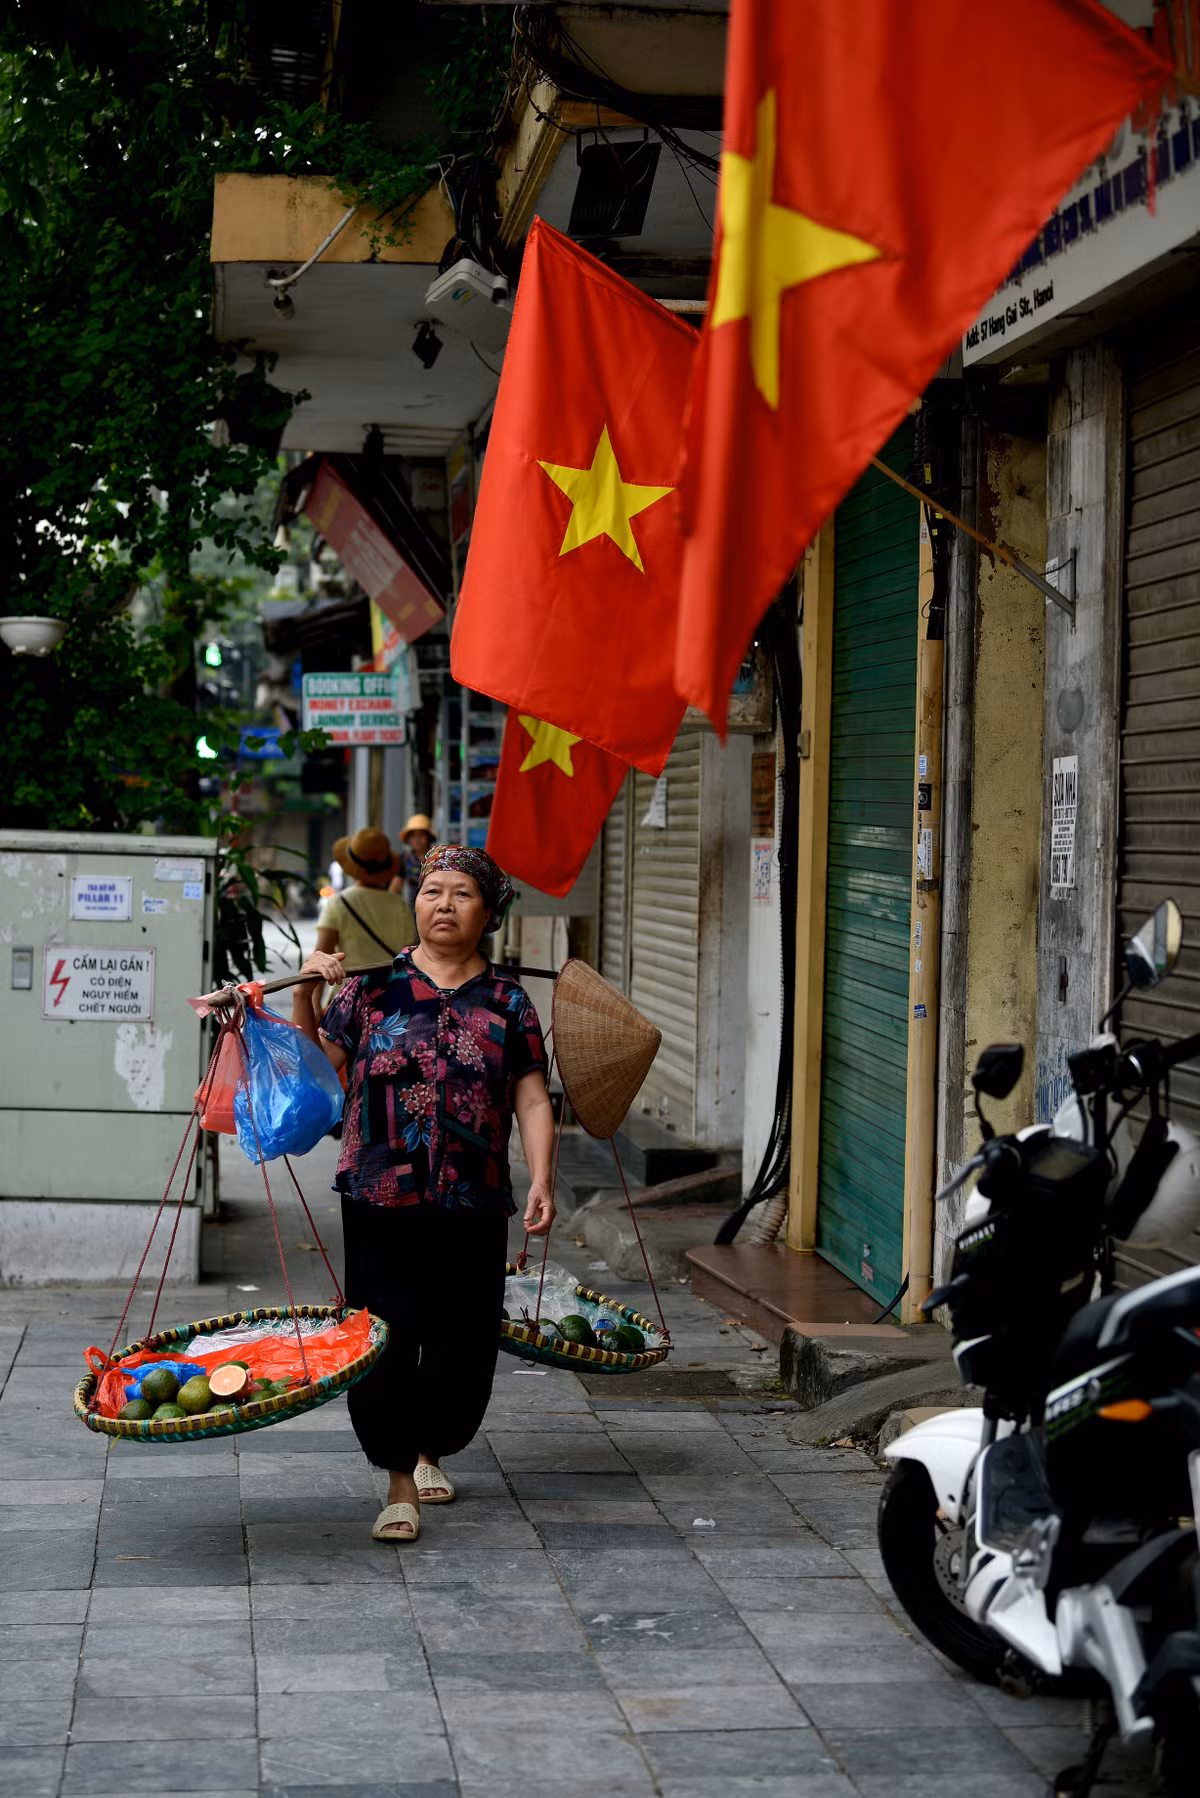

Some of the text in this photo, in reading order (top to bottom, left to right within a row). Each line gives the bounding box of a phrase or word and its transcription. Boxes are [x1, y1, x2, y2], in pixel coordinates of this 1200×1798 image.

[981, 320, 988, 342] 57
[989, 316, 1006, 337] Hang
[1006, 302, 1018, 327] Gai
[1033, 279, 1054, 311] Hanoi
[78, 893, 124, 904] PILLAR 11
[100, 959, 117, 974] LẠI
[82, 989, 111, 999] NGUY
